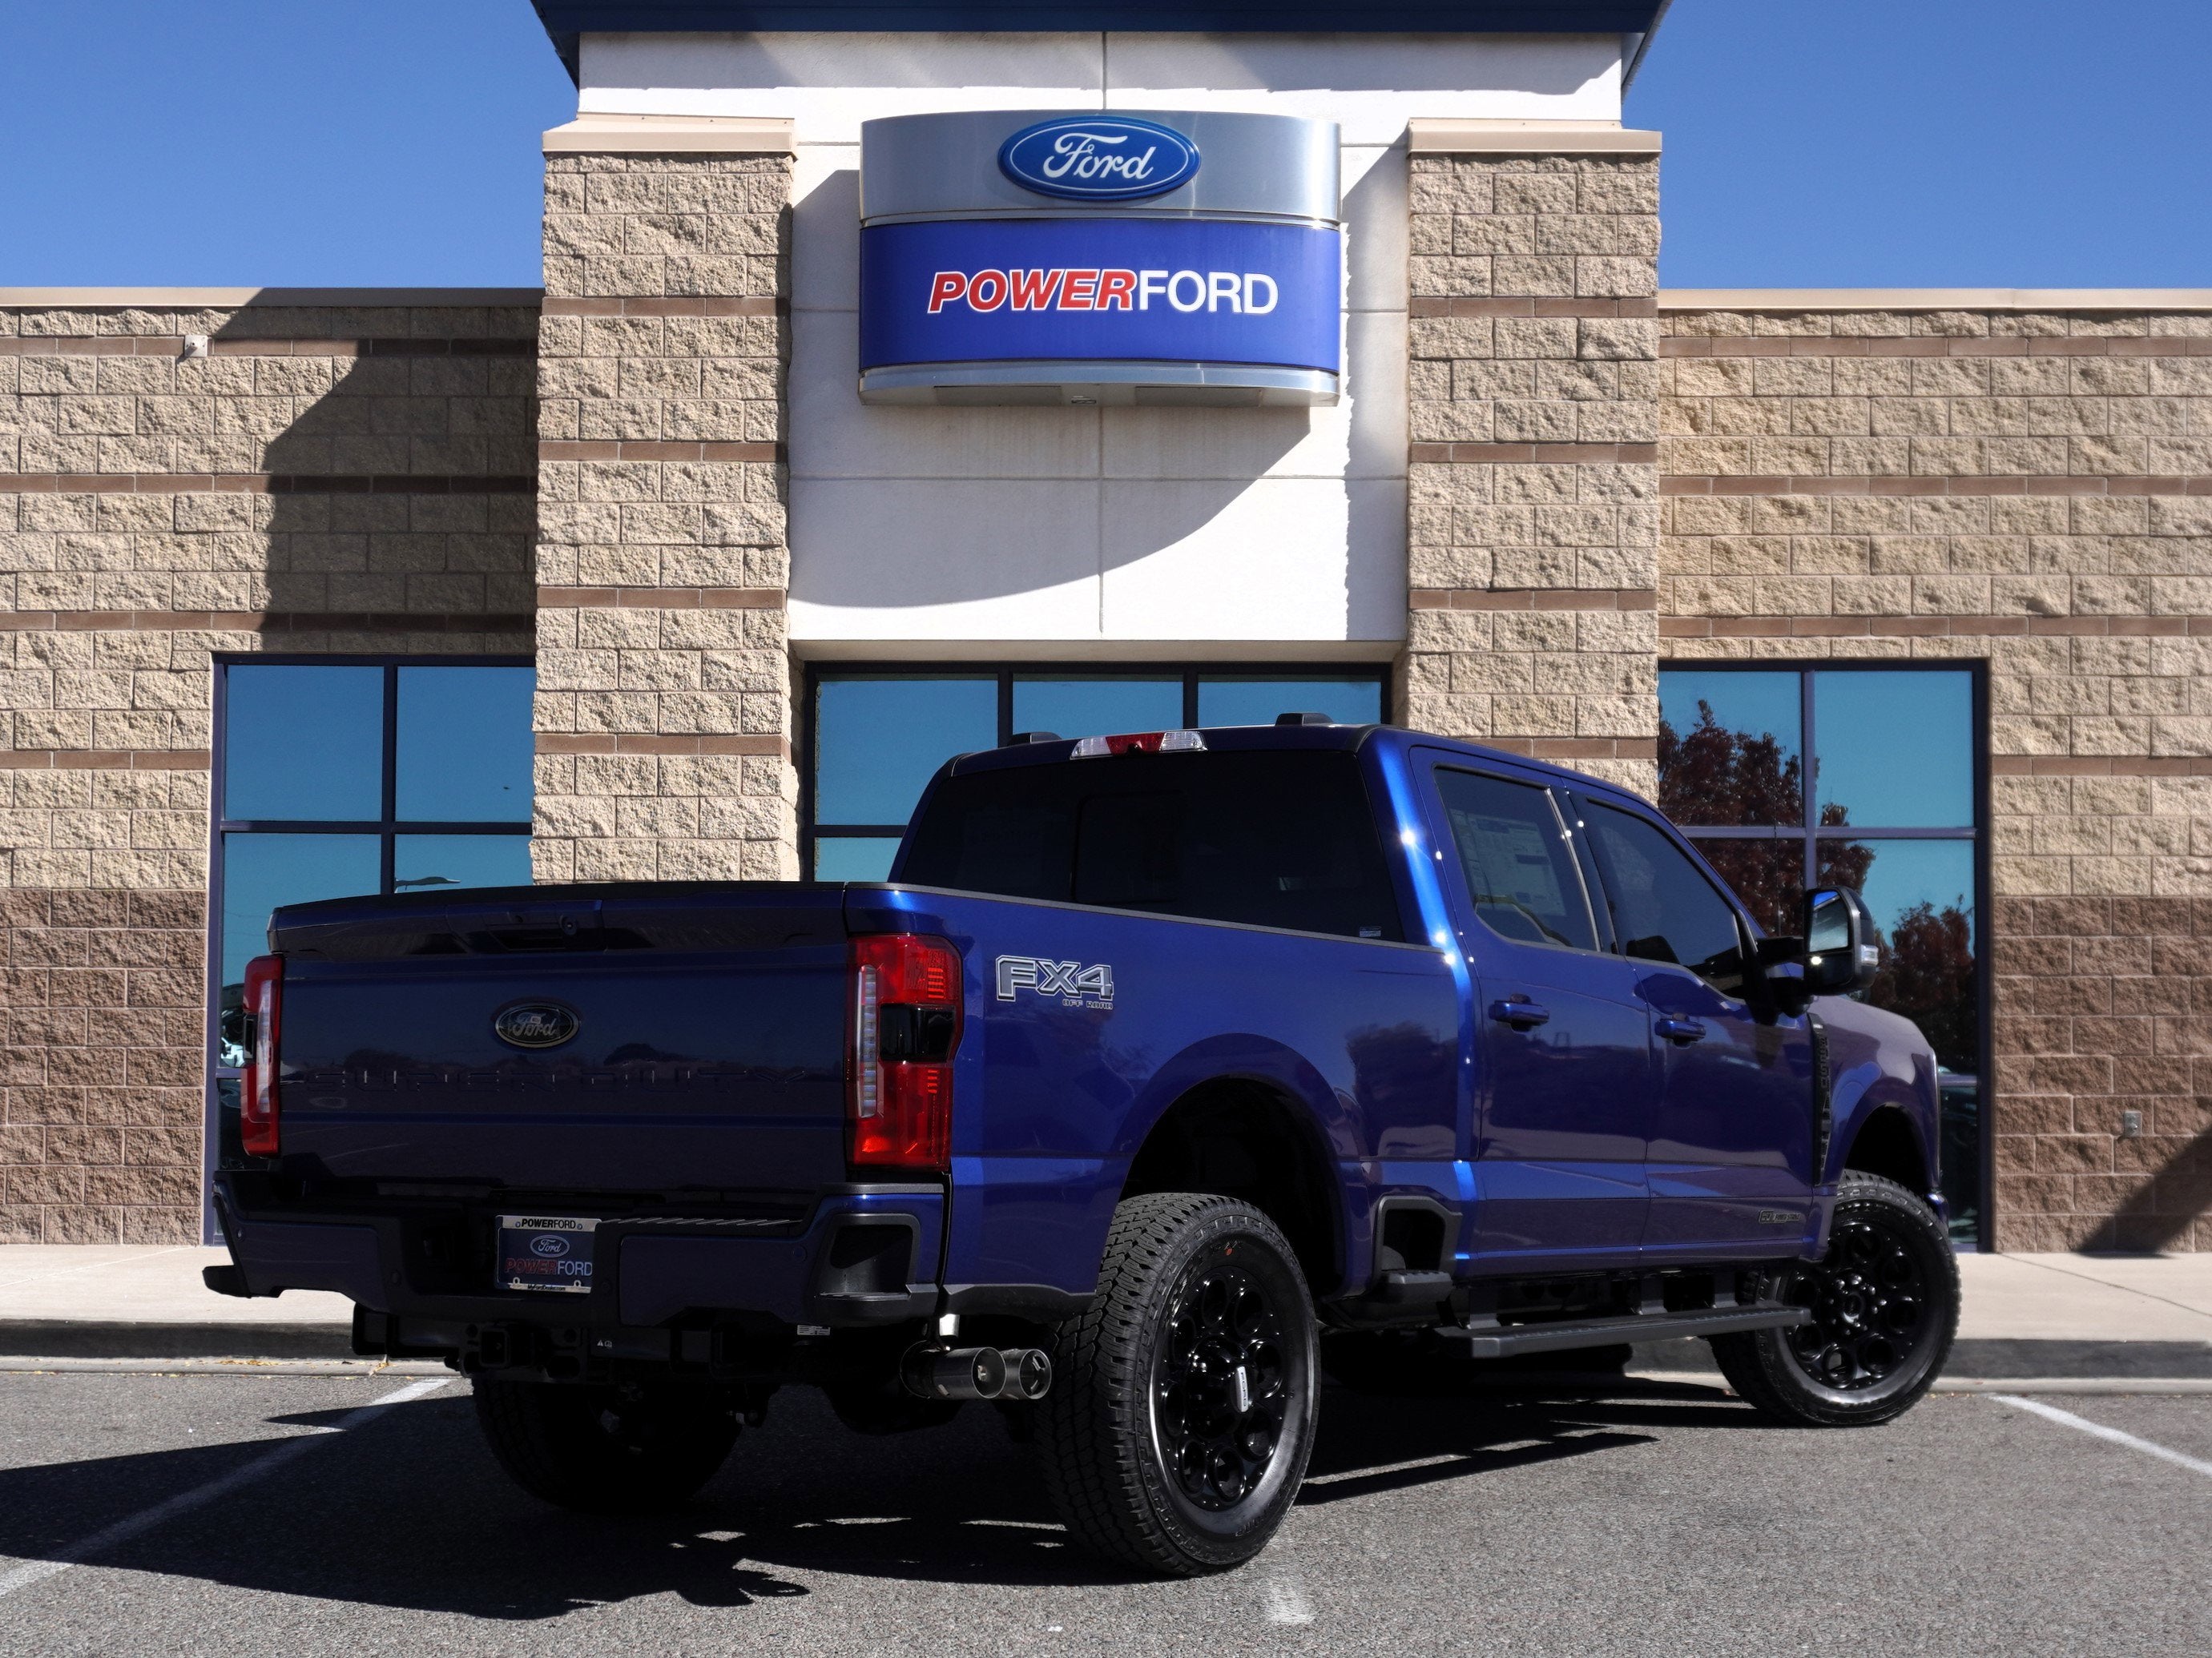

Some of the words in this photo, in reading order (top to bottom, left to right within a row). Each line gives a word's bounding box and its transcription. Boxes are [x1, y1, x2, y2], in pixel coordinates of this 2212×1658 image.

[1043, 132, 1156, 180] Ford
[926, 268, 1279, 315] POWERFORD
[995, 955, 1114, 1001] FX4
[511, 1012, 557, 1036] Ford
[521, 1218, 576, 1230] POWERFORD
[538, 1238, 562, 1254] Ford
[504, 1258, 593, 1277] POWERFORD
